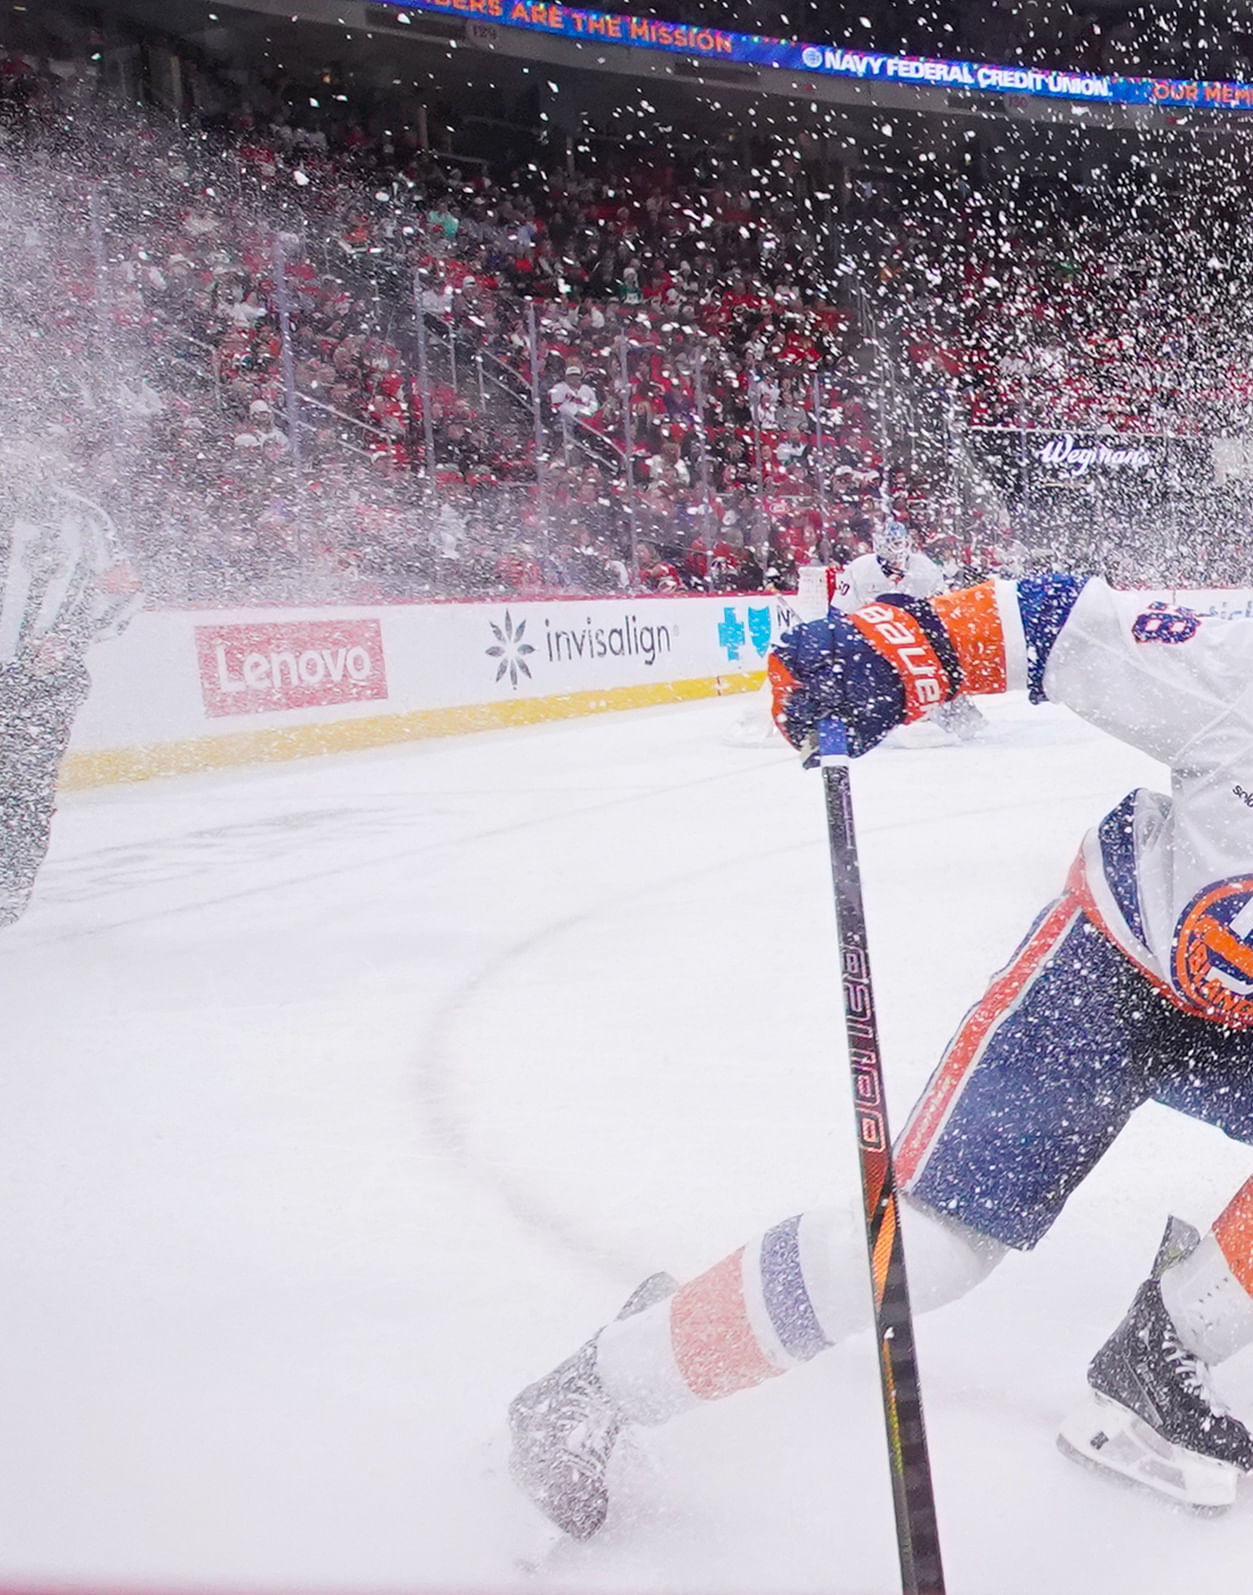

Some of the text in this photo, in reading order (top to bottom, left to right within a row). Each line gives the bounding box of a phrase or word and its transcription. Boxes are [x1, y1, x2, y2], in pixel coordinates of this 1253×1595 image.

[511, 4, 564, 28] ARE
[572, 13, 621, 38] THE
[627, 19, 733, 53] MISSION
[824, 51, 882, 76] NAVY
[887, 58, 975, 84] FEDERAL
[977, 66, 1049, 91] CREDIT
[1153, 83, 1198, 101] OUR
[1035, 434, 1150, 476] Wegmans
[546, 615, 672, 666] invisalign
[216, 644, 372, 693] Lenovo
